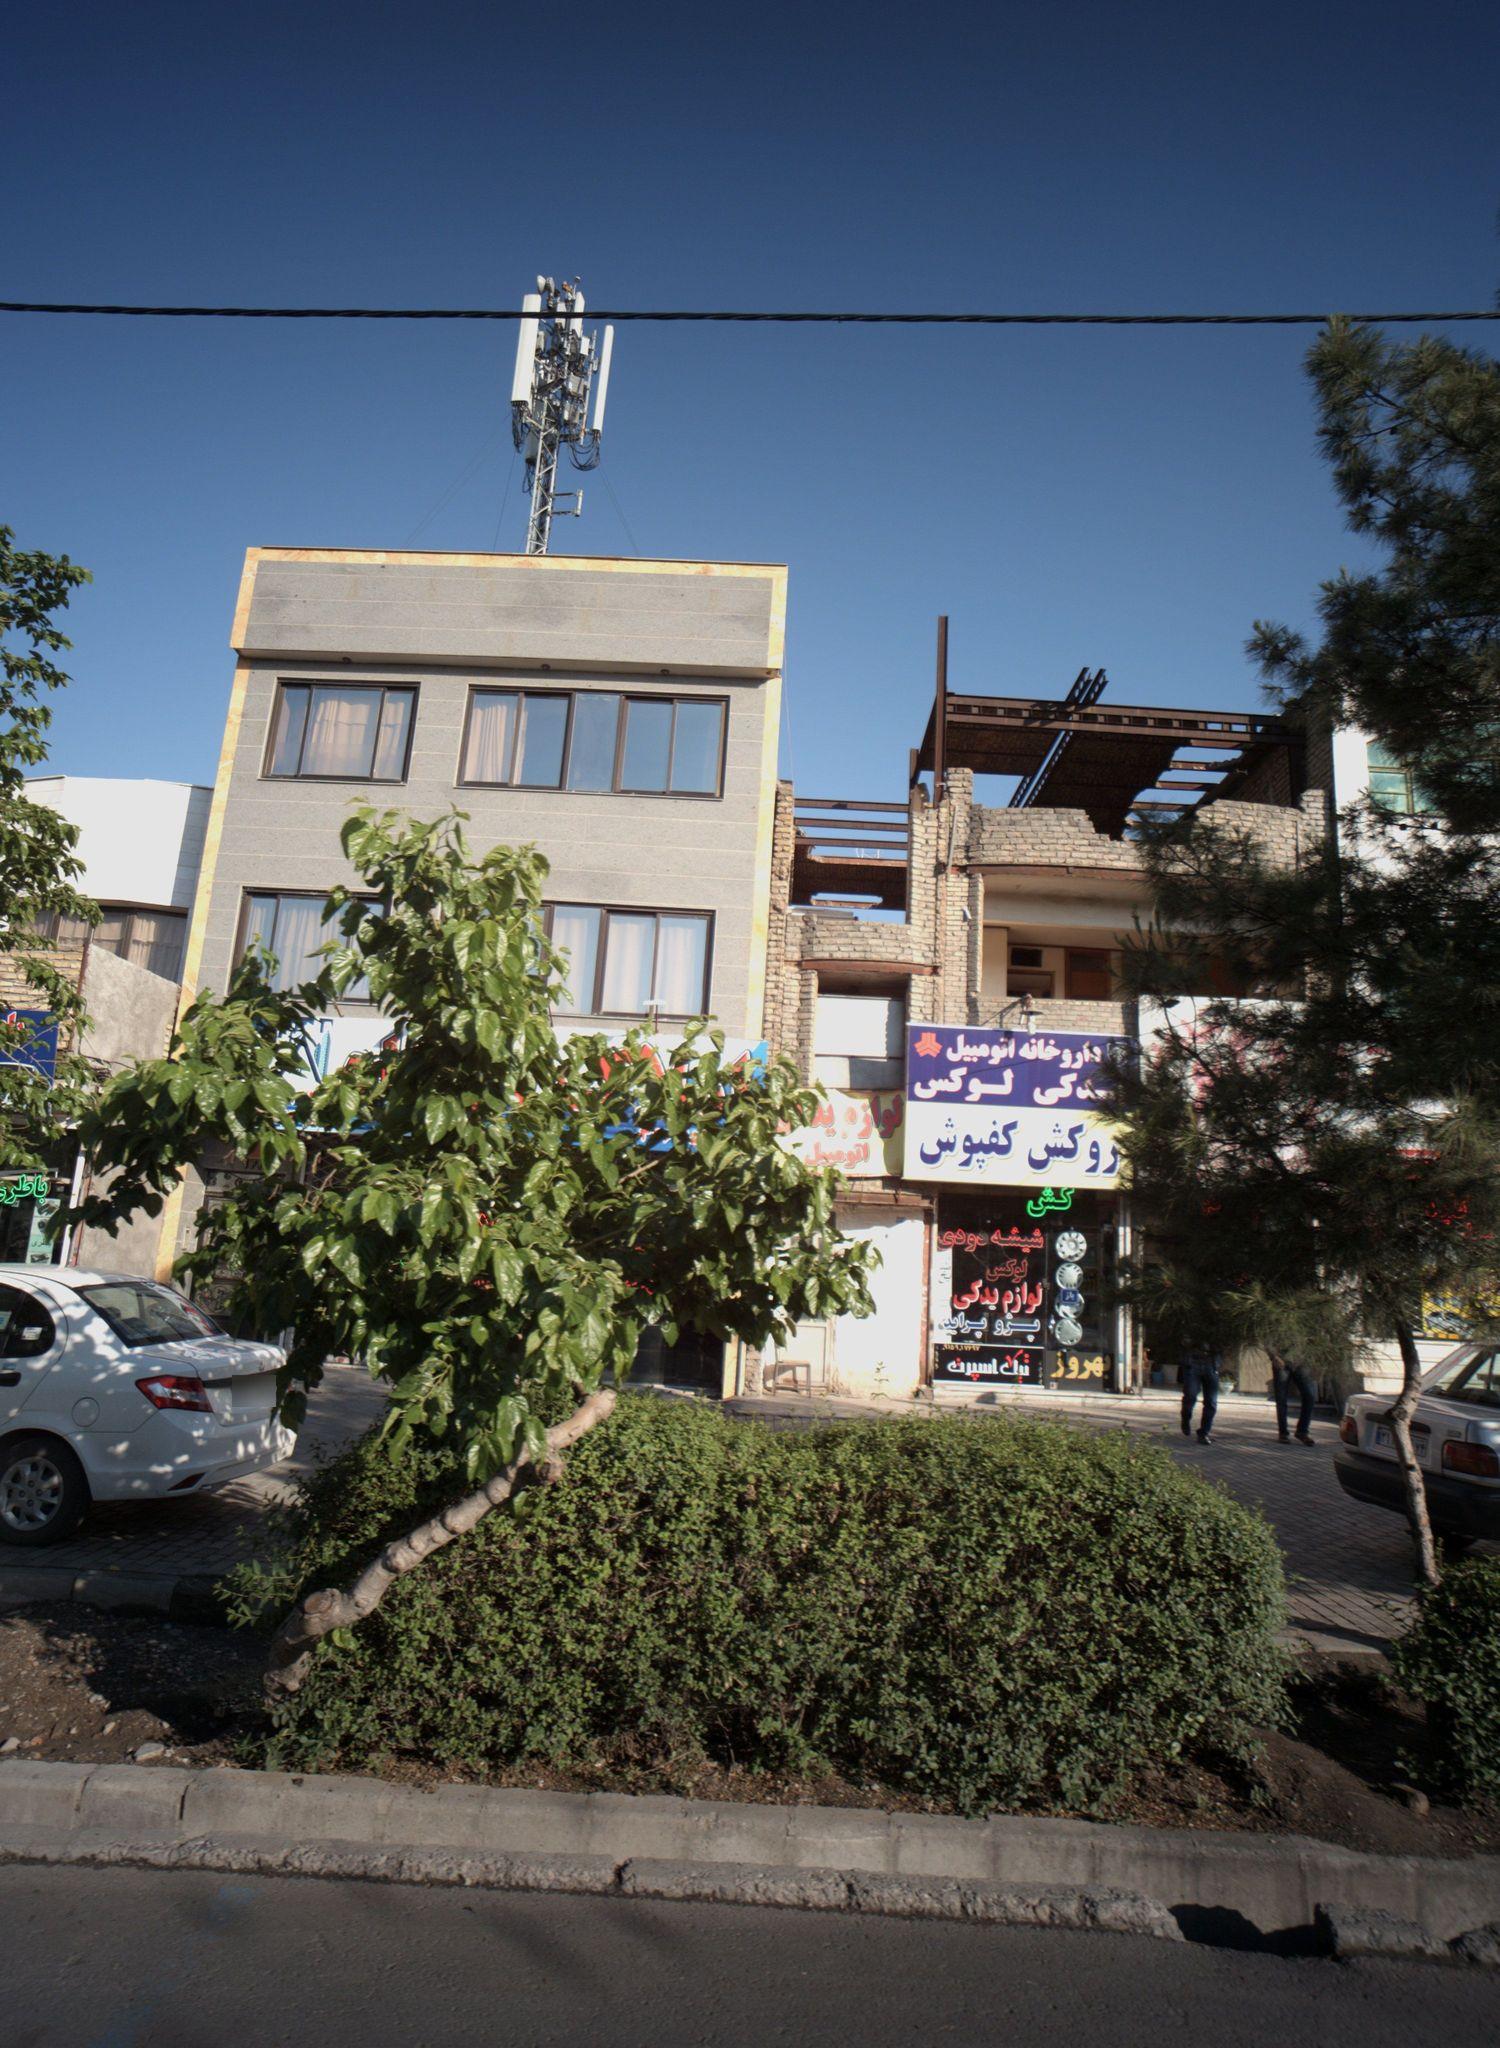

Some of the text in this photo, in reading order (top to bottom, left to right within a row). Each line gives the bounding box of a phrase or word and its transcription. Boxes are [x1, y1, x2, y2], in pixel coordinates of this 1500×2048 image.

[946, 1034, 1101, 1069] داروخانه اتومبیل
[914, 1067, 1014, 1102] لوکس
[919, 1117, 1119, 1175] روکش کفپوش
[0, 1174, 48, 1204] باطر
[937, 1226, 1044, 1253] شیشه دودی
[986, 1259, 1028, 1284] لوکس
[953, 1279, 1043, 1314] لوازم یدکی
[942, 1311, 1041, 1343] پژو پراید
[947, 1357, 998, 1382] اسپرت
[1050, 1351, 1112, 1379] بهروز
